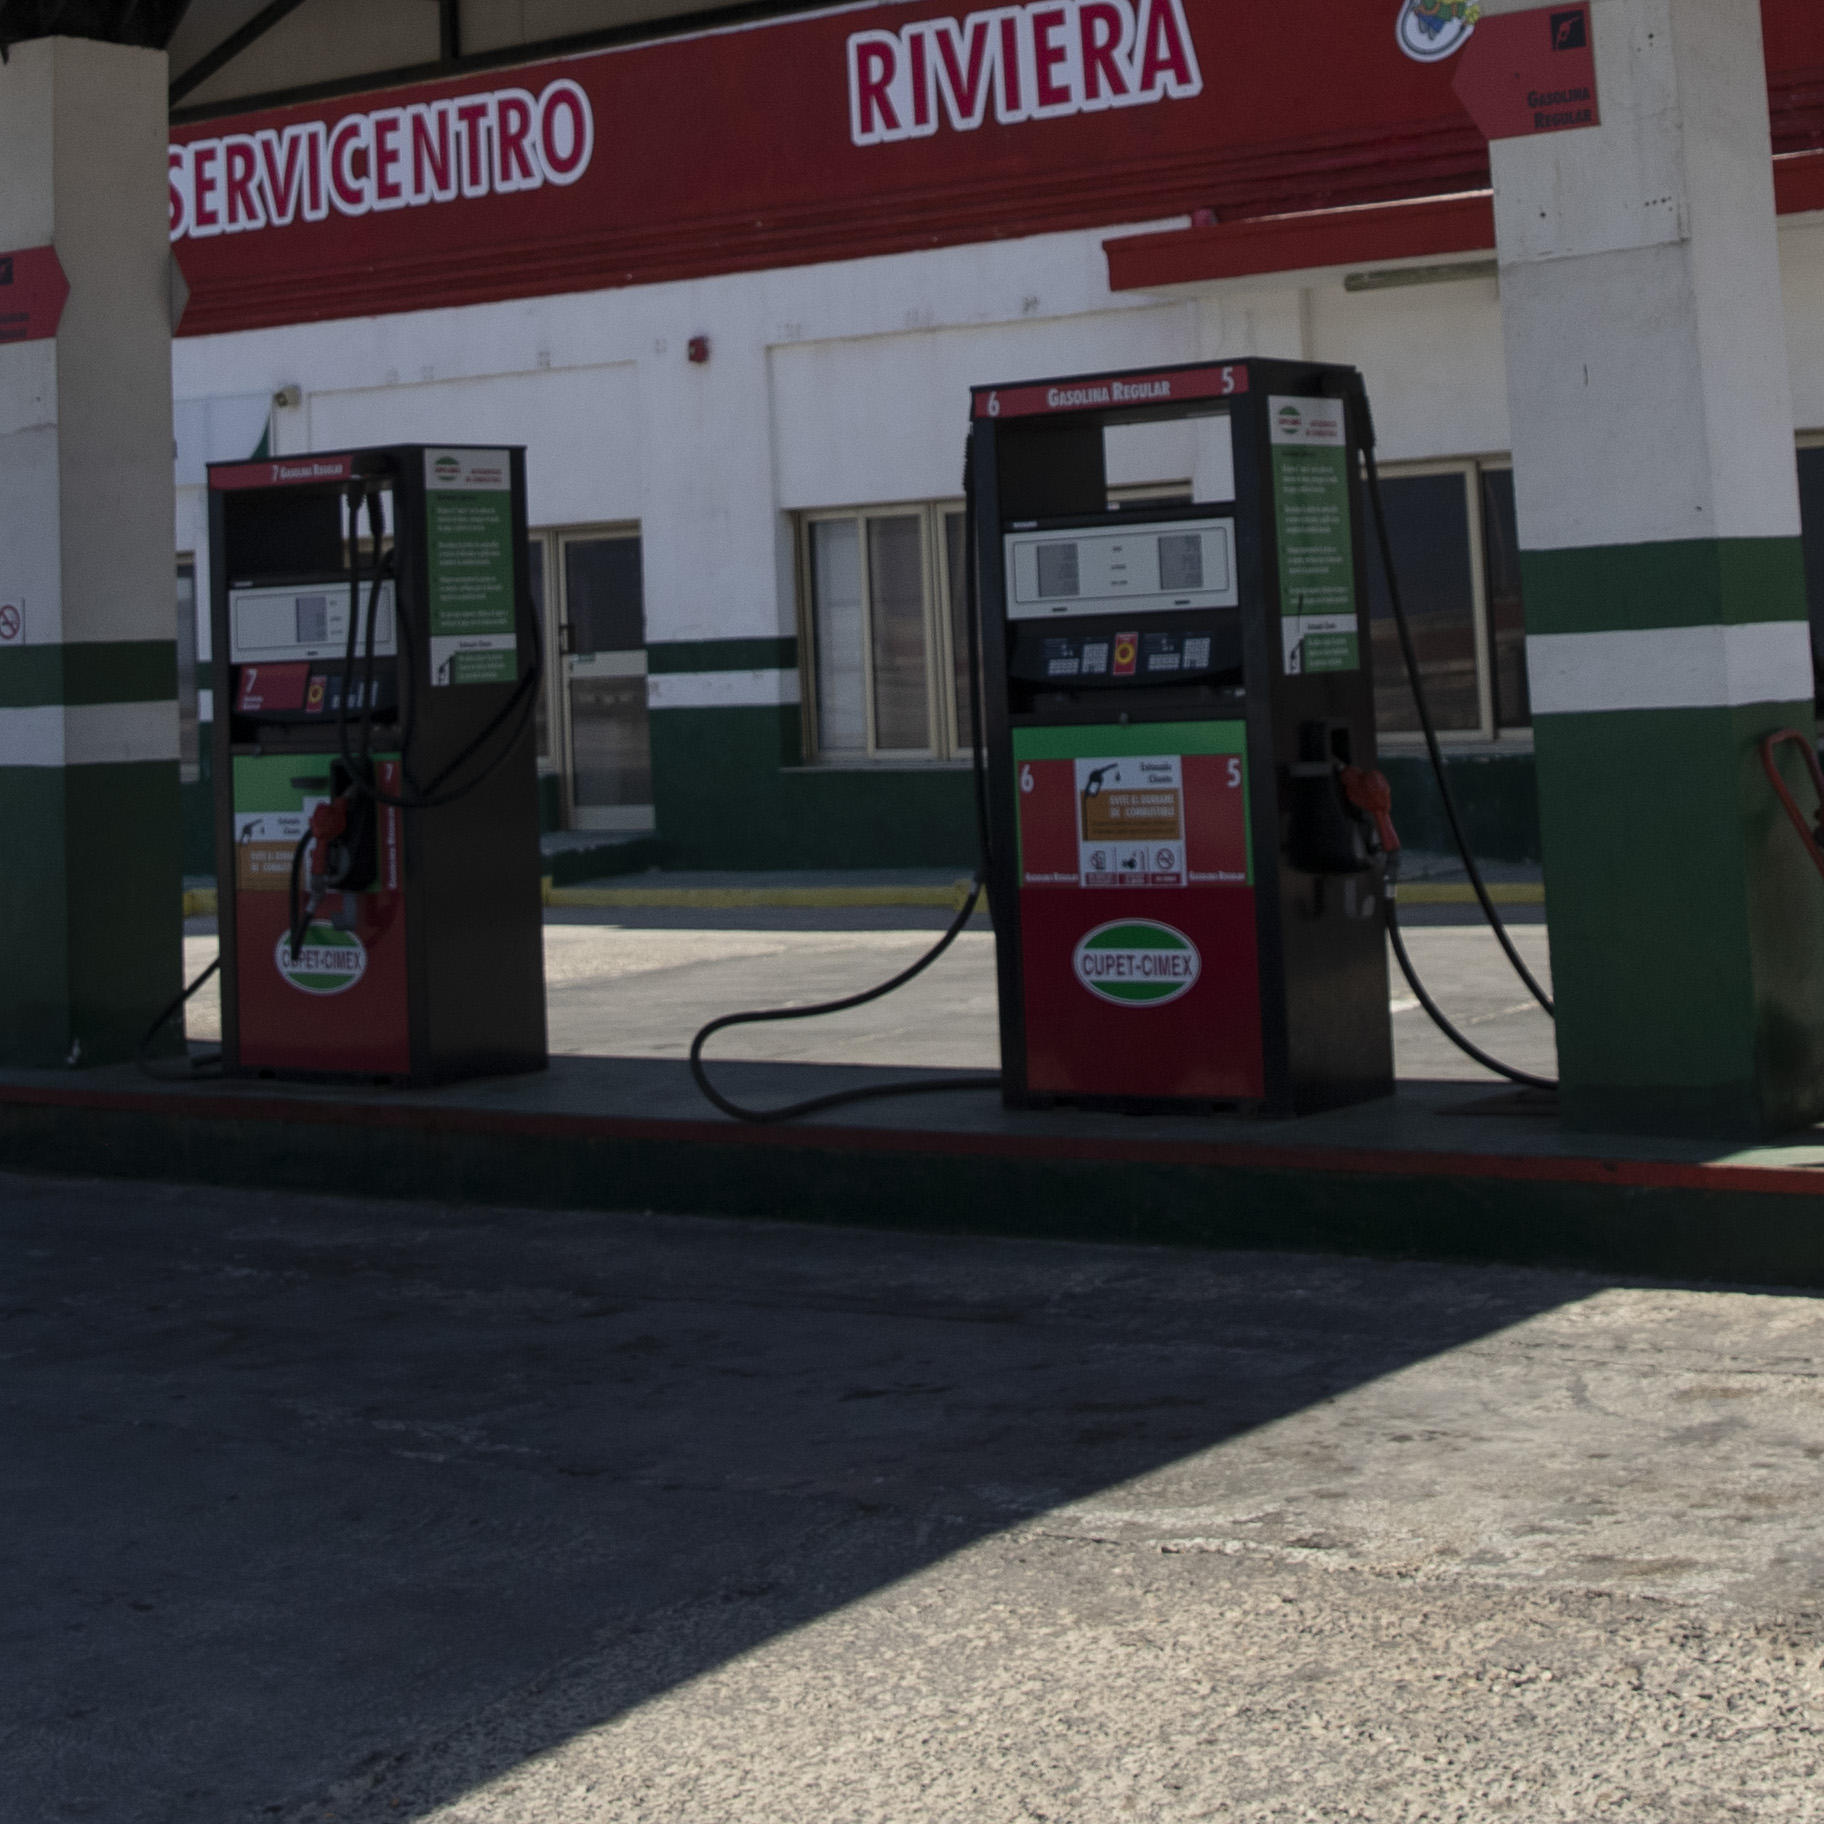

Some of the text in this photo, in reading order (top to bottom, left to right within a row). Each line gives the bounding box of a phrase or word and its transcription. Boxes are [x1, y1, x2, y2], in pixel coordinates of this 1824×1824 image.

[169, 84, 590, 236] SERVICENTRO
[1220, 366, 1235, 394] 5
[986, 390, 1000, 417] 6
[1047, 380, 1171, 408] GASOLINA REGULAR
[271, 465, 279, 482] 7
[245, 668, 258, 693] 7
[384, 762, 394, 782] 7
[1020, 764, 1035, 793] 6
[1226, 758, 1241, 788] 5
[1082, 953, 1194, 977] CUPET-CIMEX
